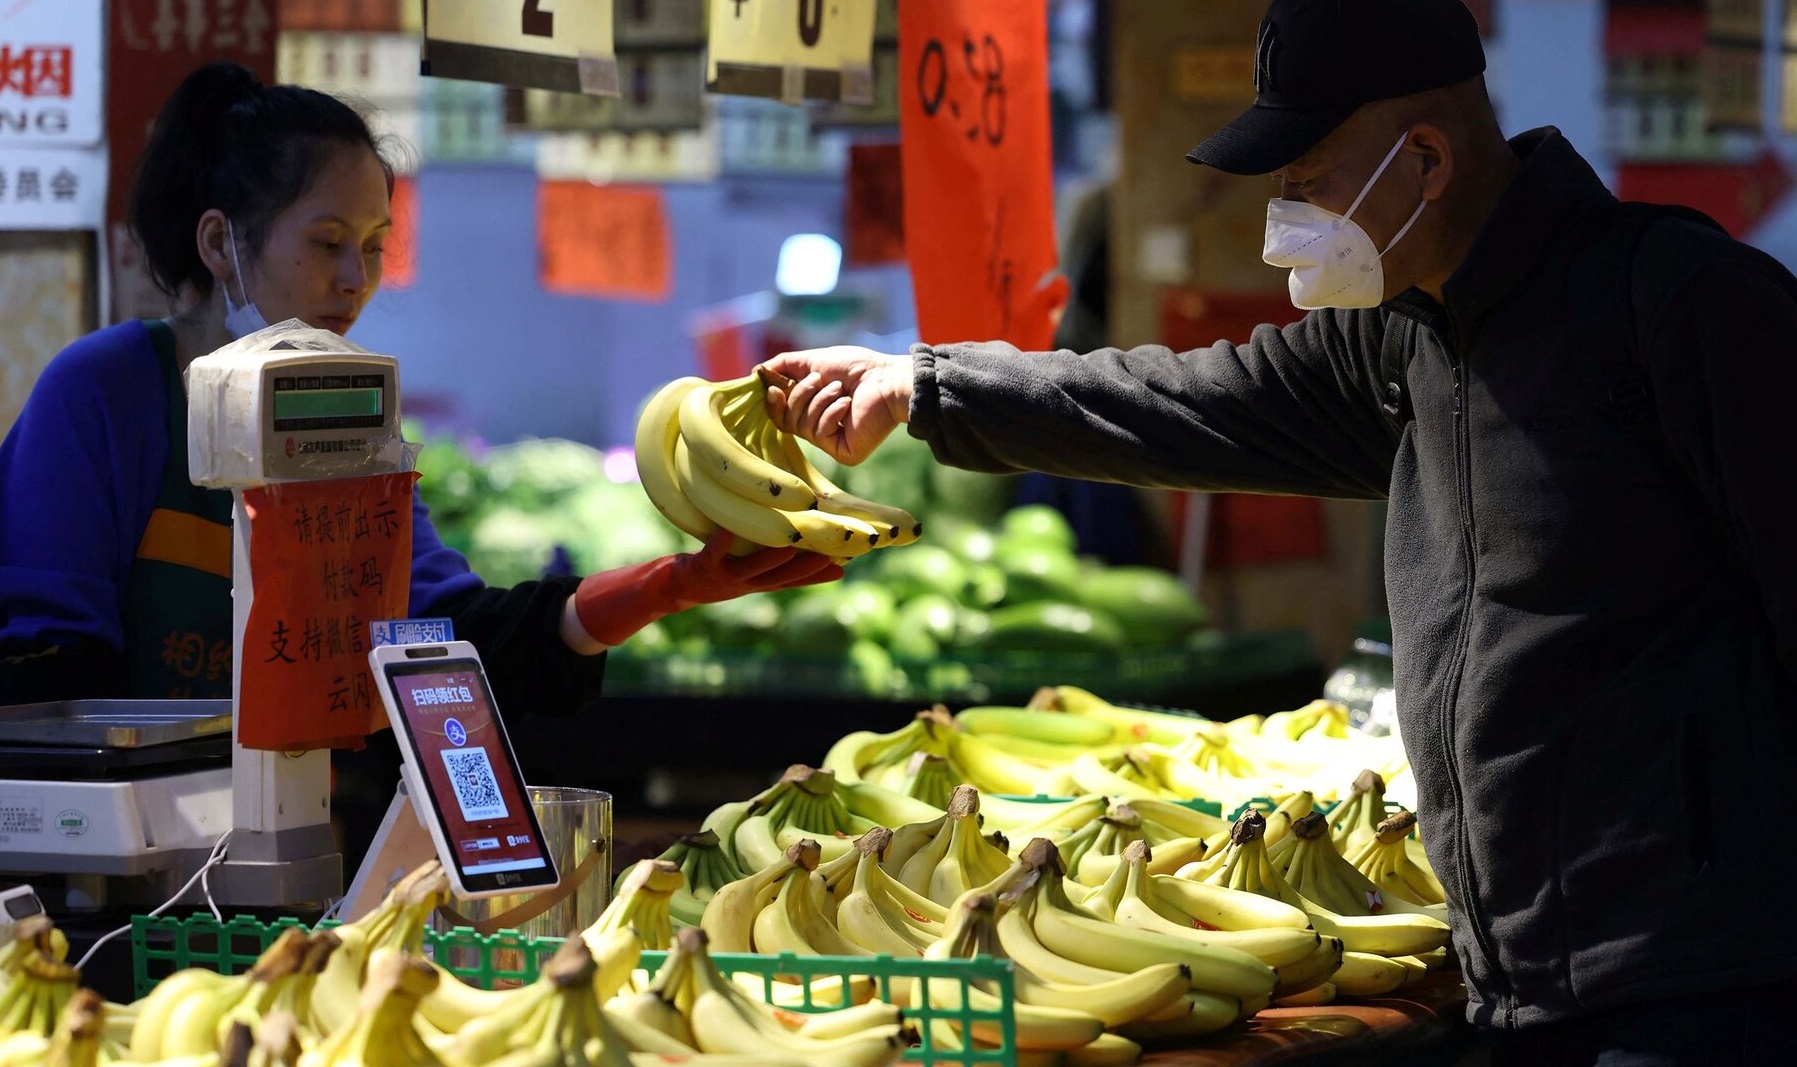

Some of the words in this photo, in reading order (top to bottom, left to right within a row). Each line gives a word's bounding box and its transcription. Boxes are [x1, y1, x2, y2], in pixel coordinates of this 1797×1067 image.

[0, 166, 79, 200] 员会
[294, 499, 399, 545] 请提前出示
[322, 556, 383, 602] 付款码
[264, 614, 363, 664] 支持微信
[395, 621, 446, 645] 刷脸支付
[328, 672, 371, 713] 云闪
[411, 685, 473, 706] 扫码领红包
